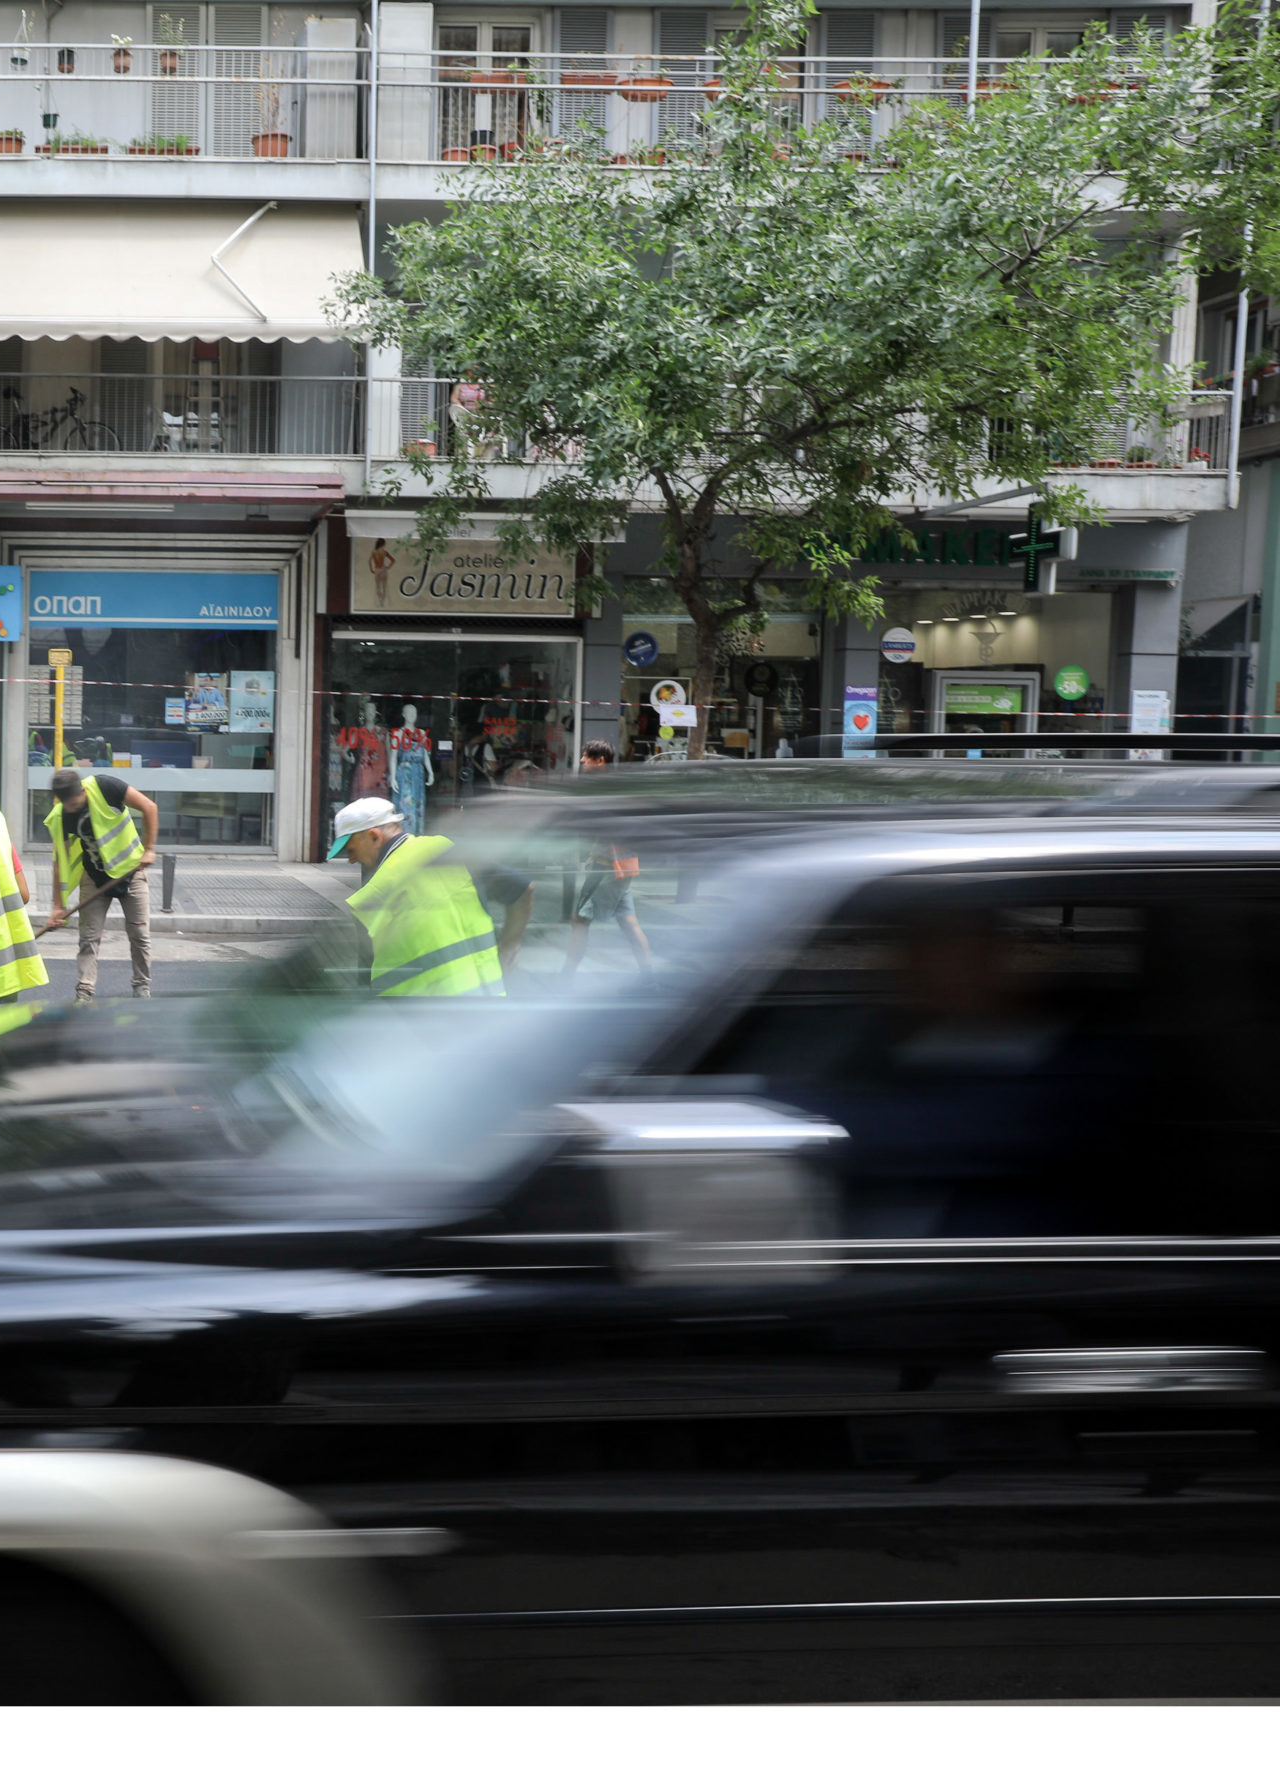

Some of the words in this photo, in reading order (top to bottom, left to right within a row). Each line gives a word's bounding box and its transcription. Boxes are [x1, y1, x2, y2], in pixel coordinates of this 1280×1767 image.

[453, 553, 508, 569] atelie
[399, 548, 564, 601] Jasmin
[199, 604, 273, 617] ΑΪΔΙΝΙΔΟΥ
[336, 727, 379, 750] 40%
[390, 728, 433, 750] 50%
